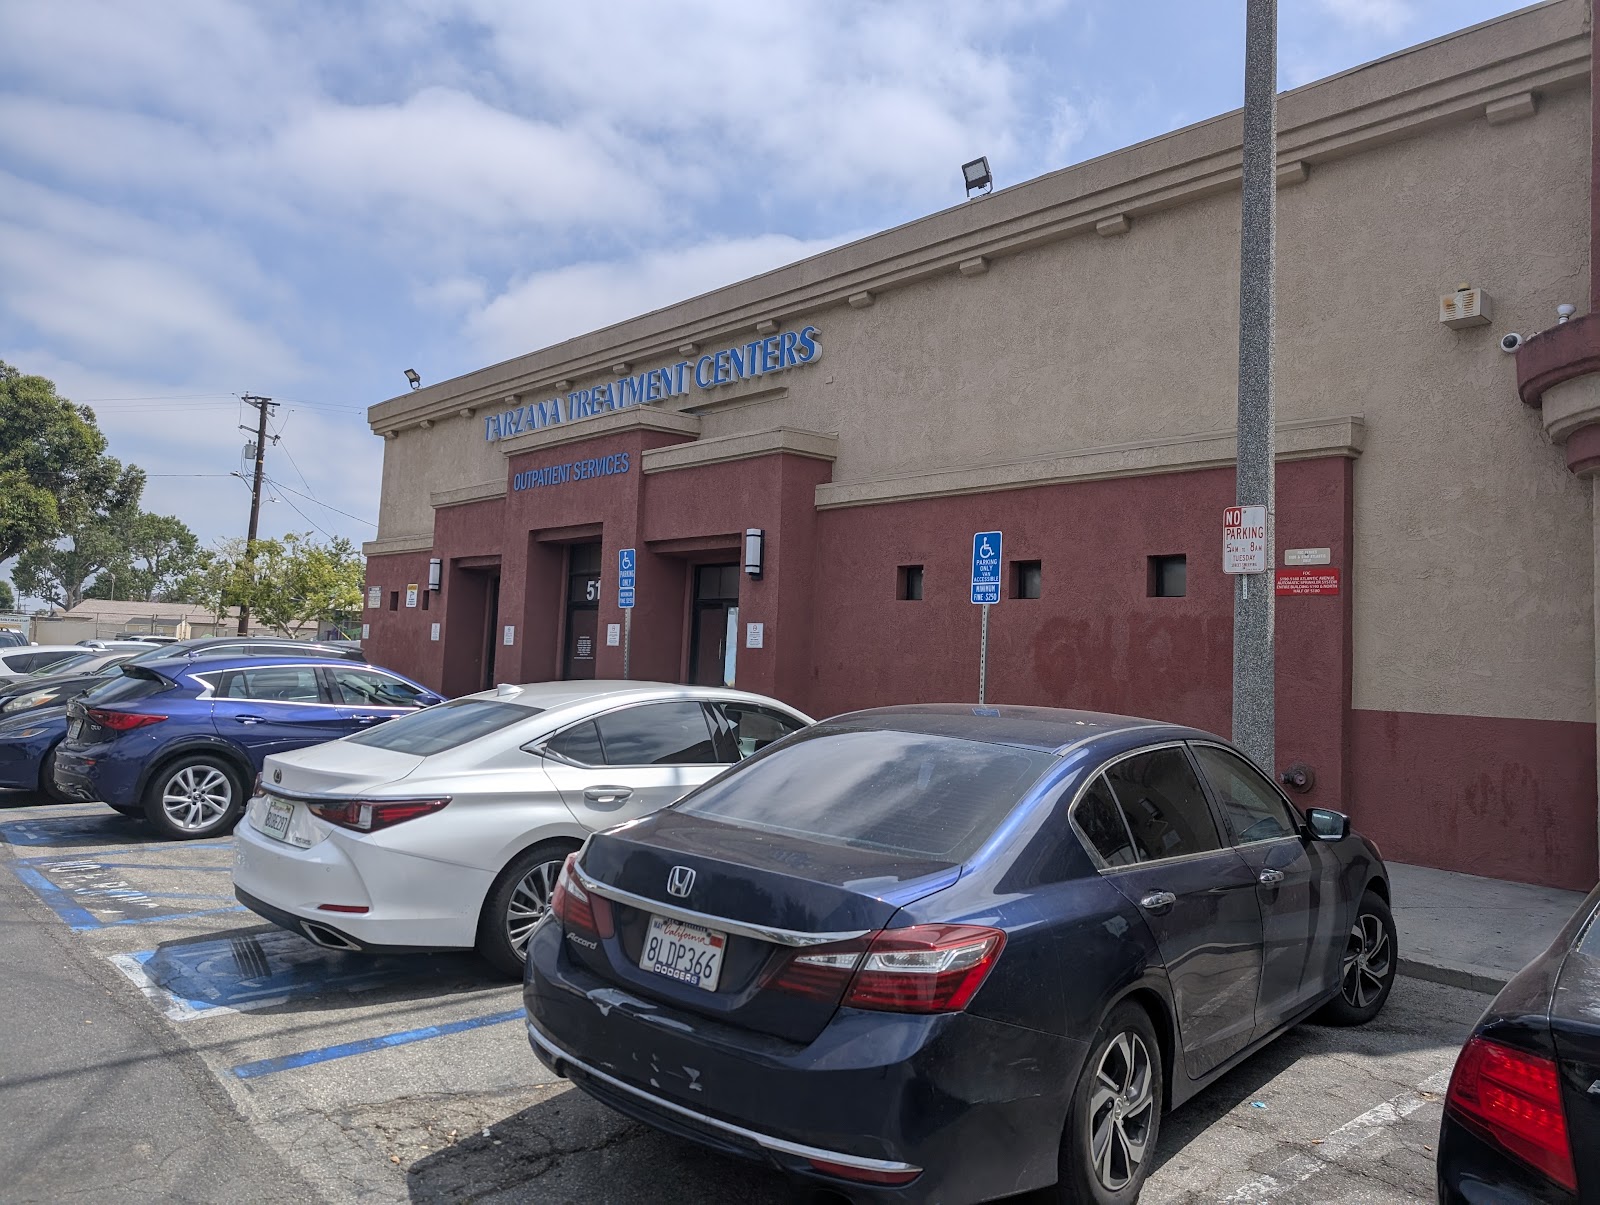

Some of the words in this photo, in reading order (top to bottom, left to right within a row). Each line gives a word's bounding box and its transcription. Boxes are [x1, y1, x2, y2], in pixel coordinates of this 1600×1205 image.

[484, 398, 565, 442] TARZANA
[567, 361, 692, 421] TREATMENT
[695, 325, 821, 389] CENTERS
[514, 463, 572, 492] OUTPATIENT
[573, 452, 630, 481] SERVICES
[1226, 510, 1241, 526] NO
[1226, 526, 1264, 540] PARKING
[1233, 554, 1256, 562] TUESDAY
[976, 584, 996, 593] MINIMUM
[985, 593, 997, 601] $250
[566, 931, 598, 950] Accord
[664, 922, 710, 946] California
[647, 936, 717, 979] 8LDP366
[654, 963, 698, 985] DODGERS
